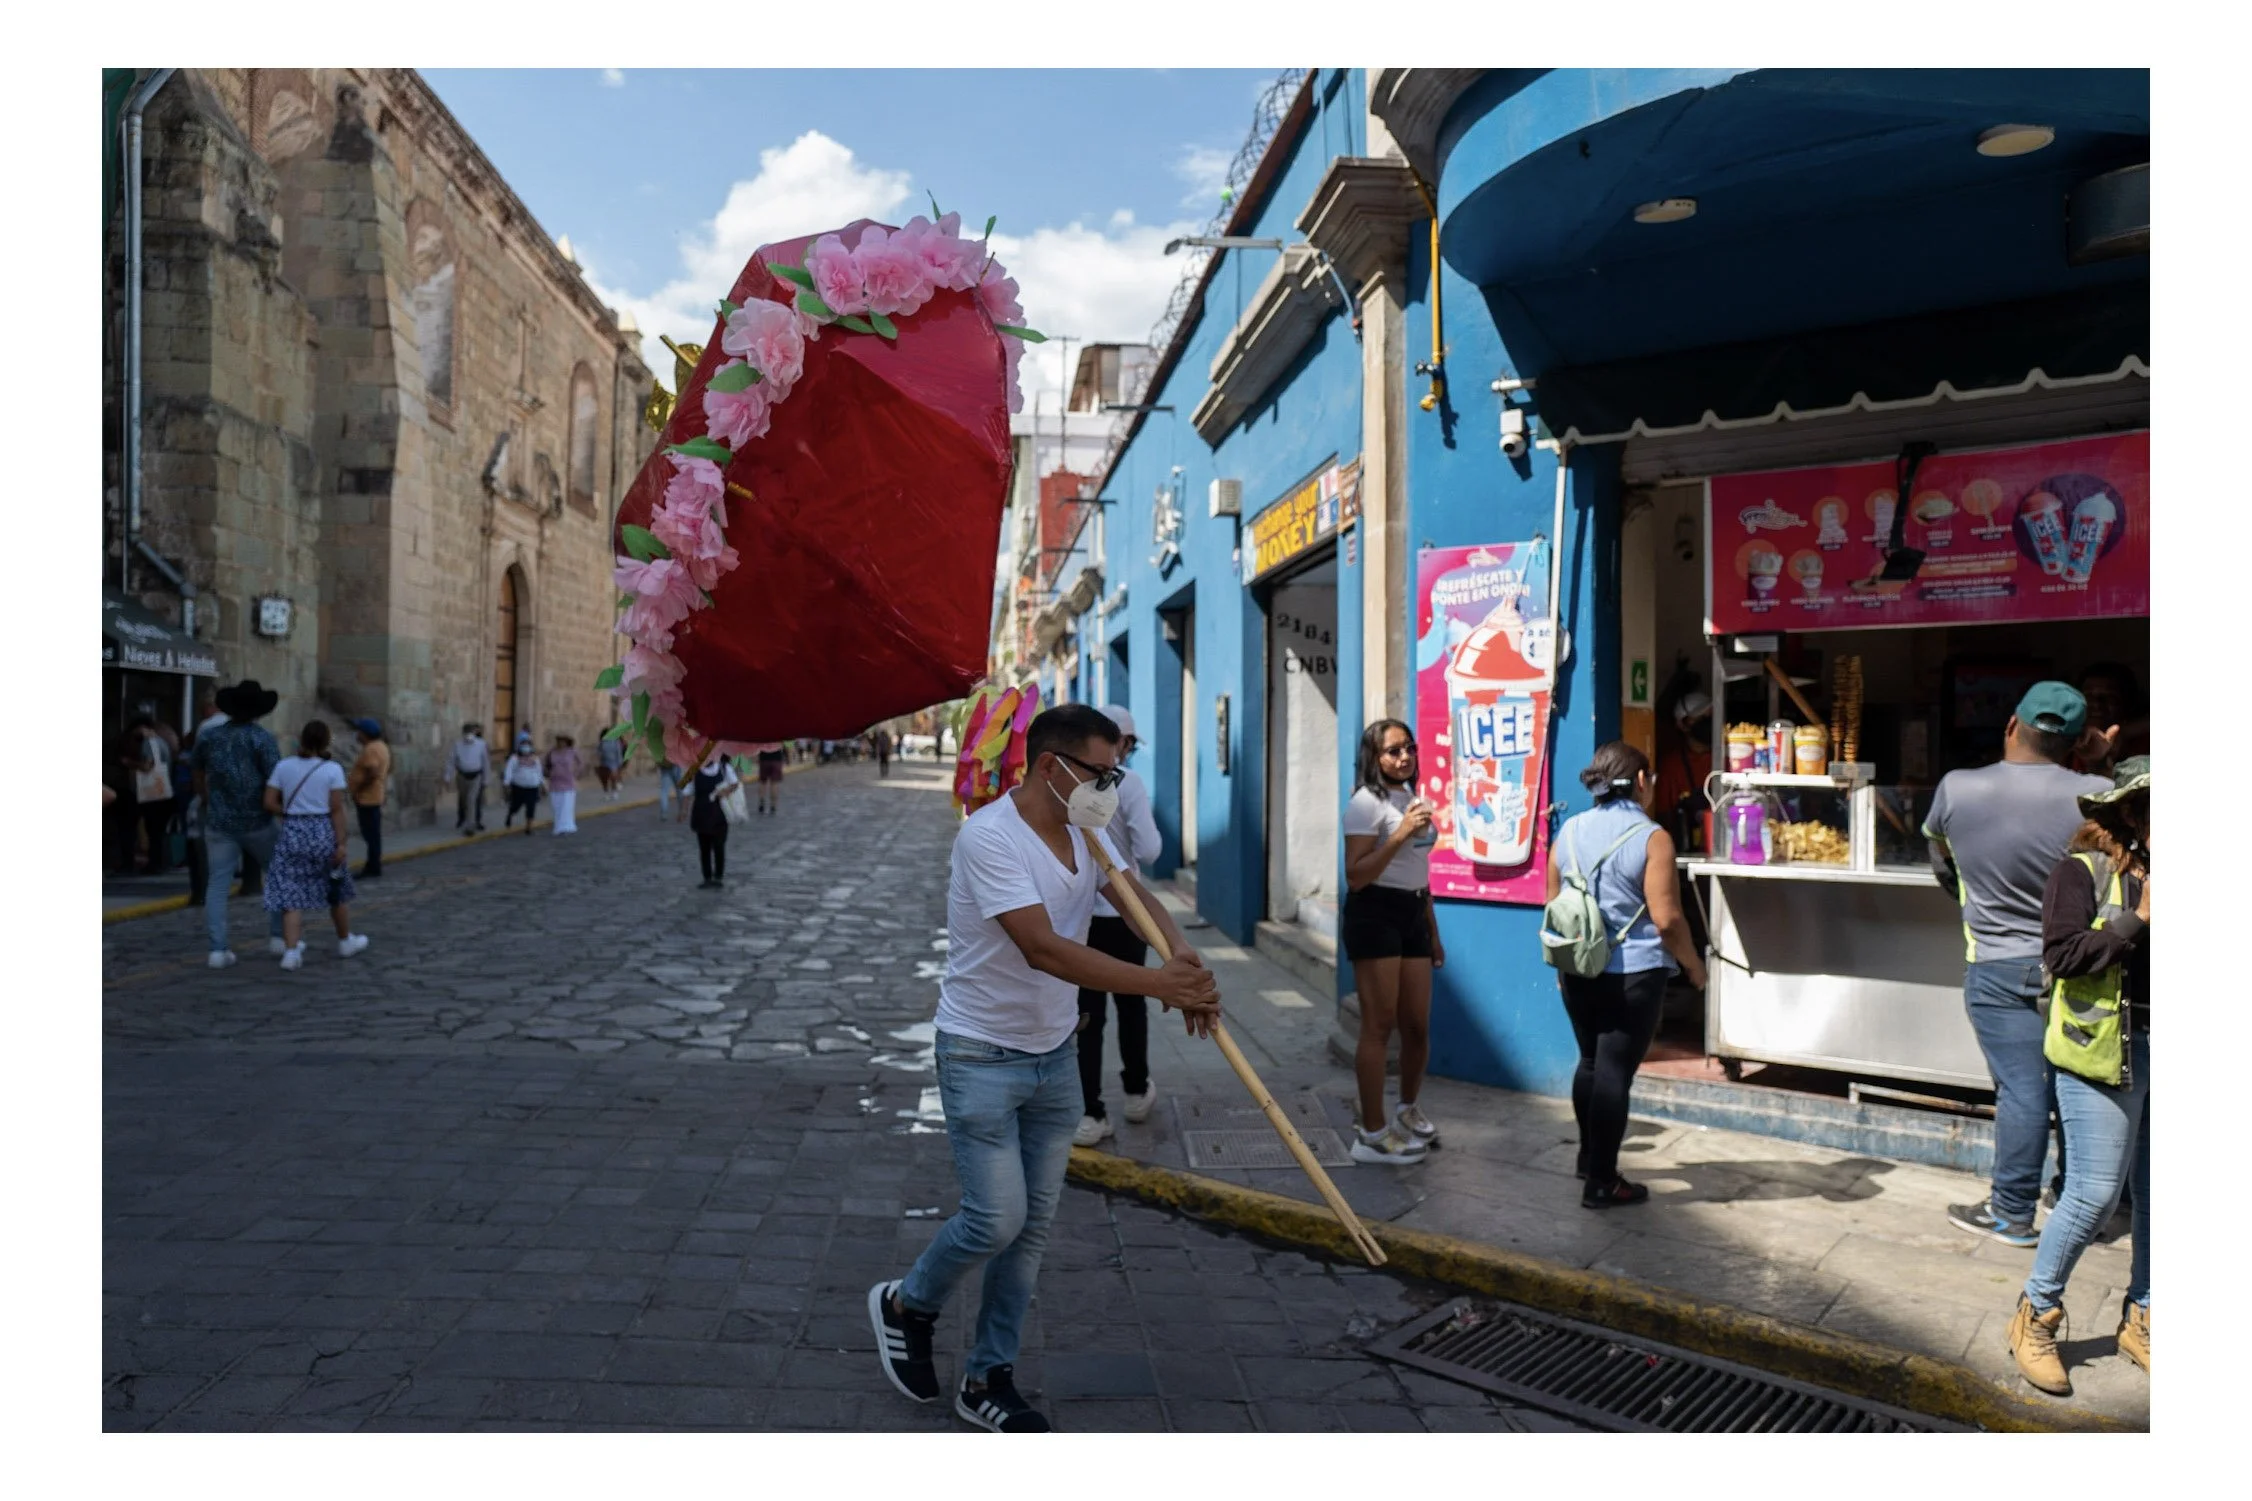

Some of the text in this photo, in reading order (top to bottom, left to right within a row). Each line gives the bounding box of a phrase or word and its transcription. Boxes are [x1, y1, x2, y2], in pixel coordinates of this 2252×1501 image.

[1431, 591, 1471, 606] PONTE
[1471, 586, 1490, 602] EN
[1460, 704, 1534, 759] ICEE
